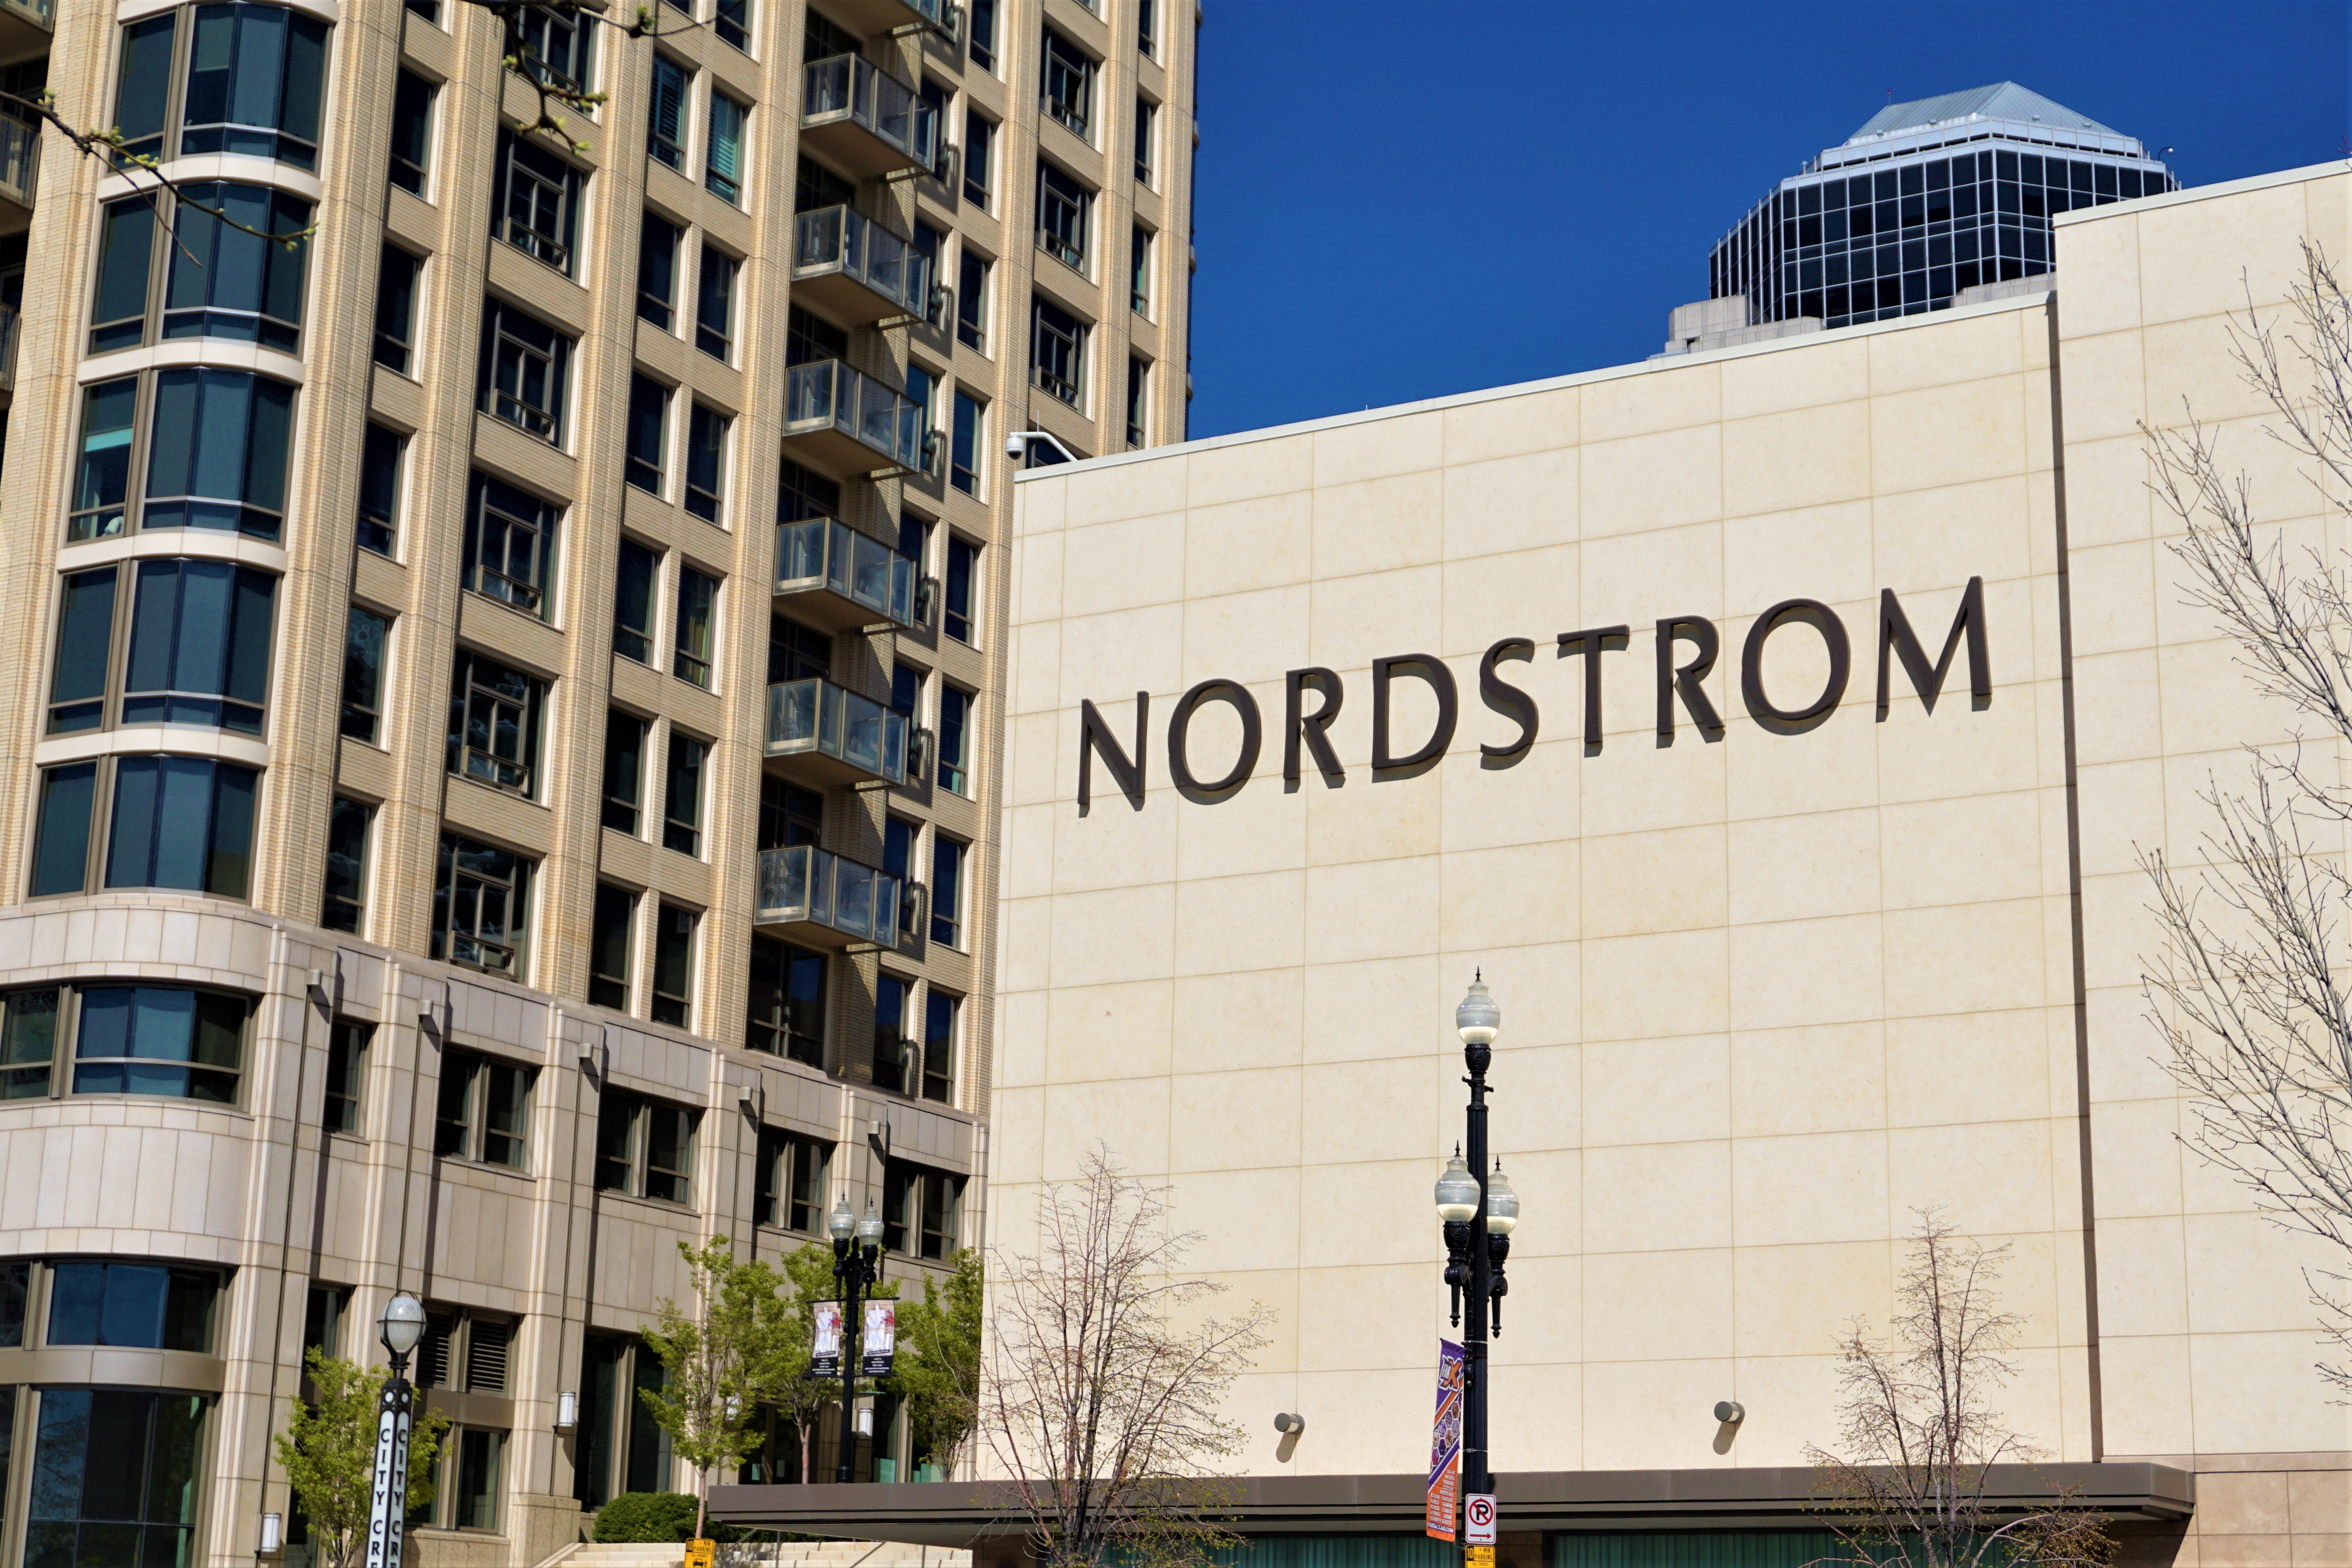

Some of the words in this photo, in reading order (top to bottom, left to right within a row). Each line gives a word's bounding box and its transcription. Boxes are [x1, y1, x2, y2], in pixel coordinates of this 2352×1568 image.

[1078, 576, 1992, 817] NORDSTROM
[376, 1428, 390, 1505] CITY
[393, 1429, 406, 1505] CITY
[687, 1541, 693, 1551] 10
[1467, 1548, 1474, 1559] 10
